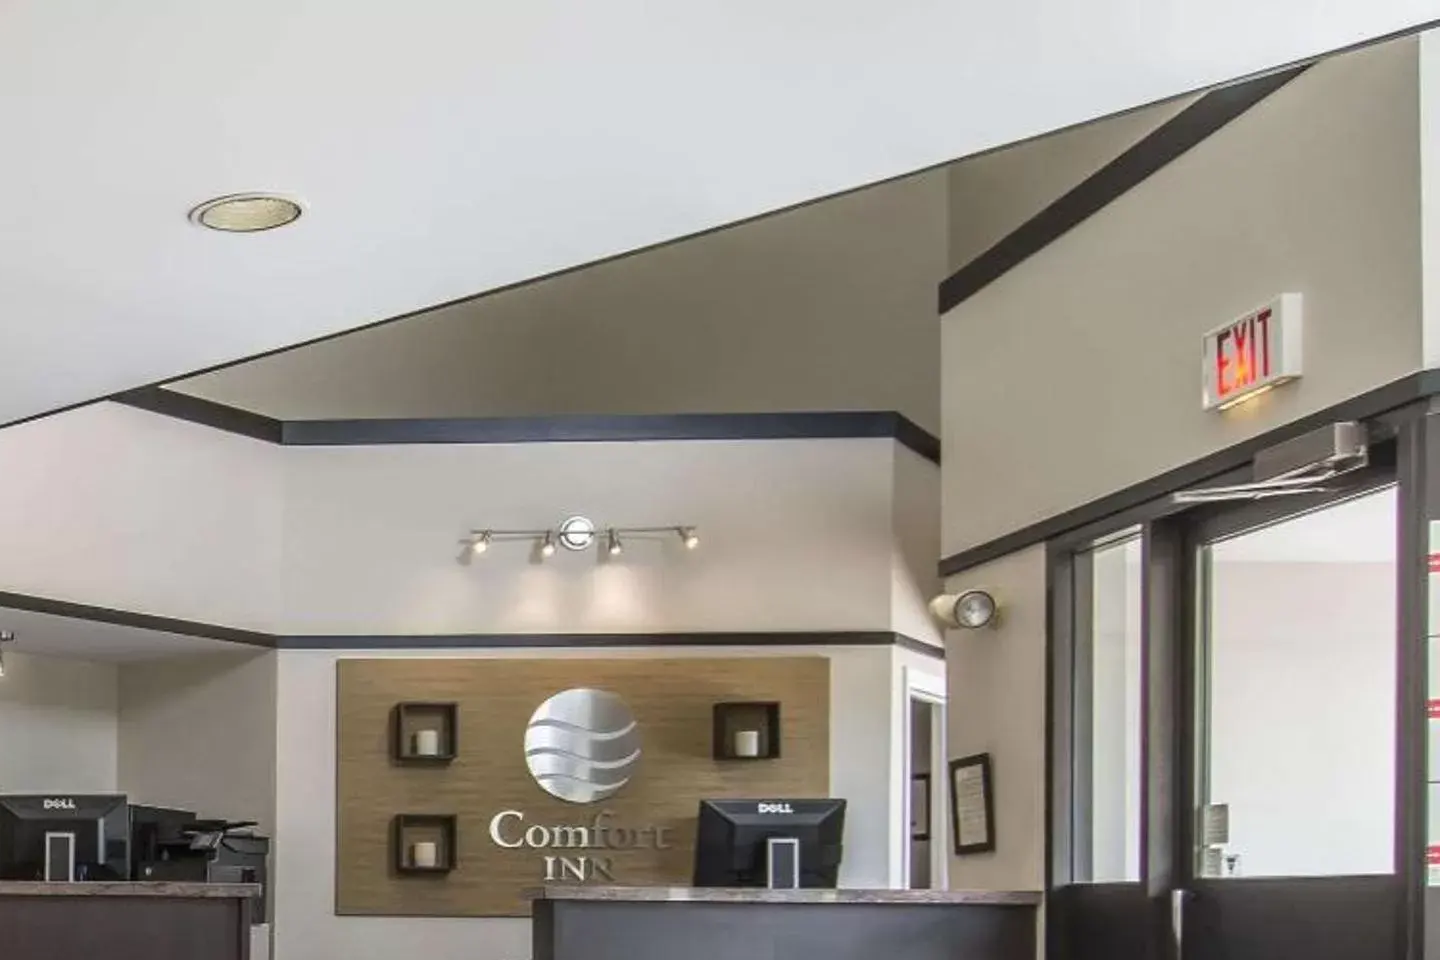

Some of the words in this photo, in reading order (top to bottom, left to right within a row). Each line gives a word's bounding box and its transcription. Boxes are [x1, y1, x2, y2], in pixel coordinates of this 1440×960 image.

[1217, 309, 1272, 396] EXIT
[43, 798, 76, 809] DELL
[758, 803, 794, 813] DELL
[489, 810, 673, 849] Comfort
[544, 855, 614, 881] INN
